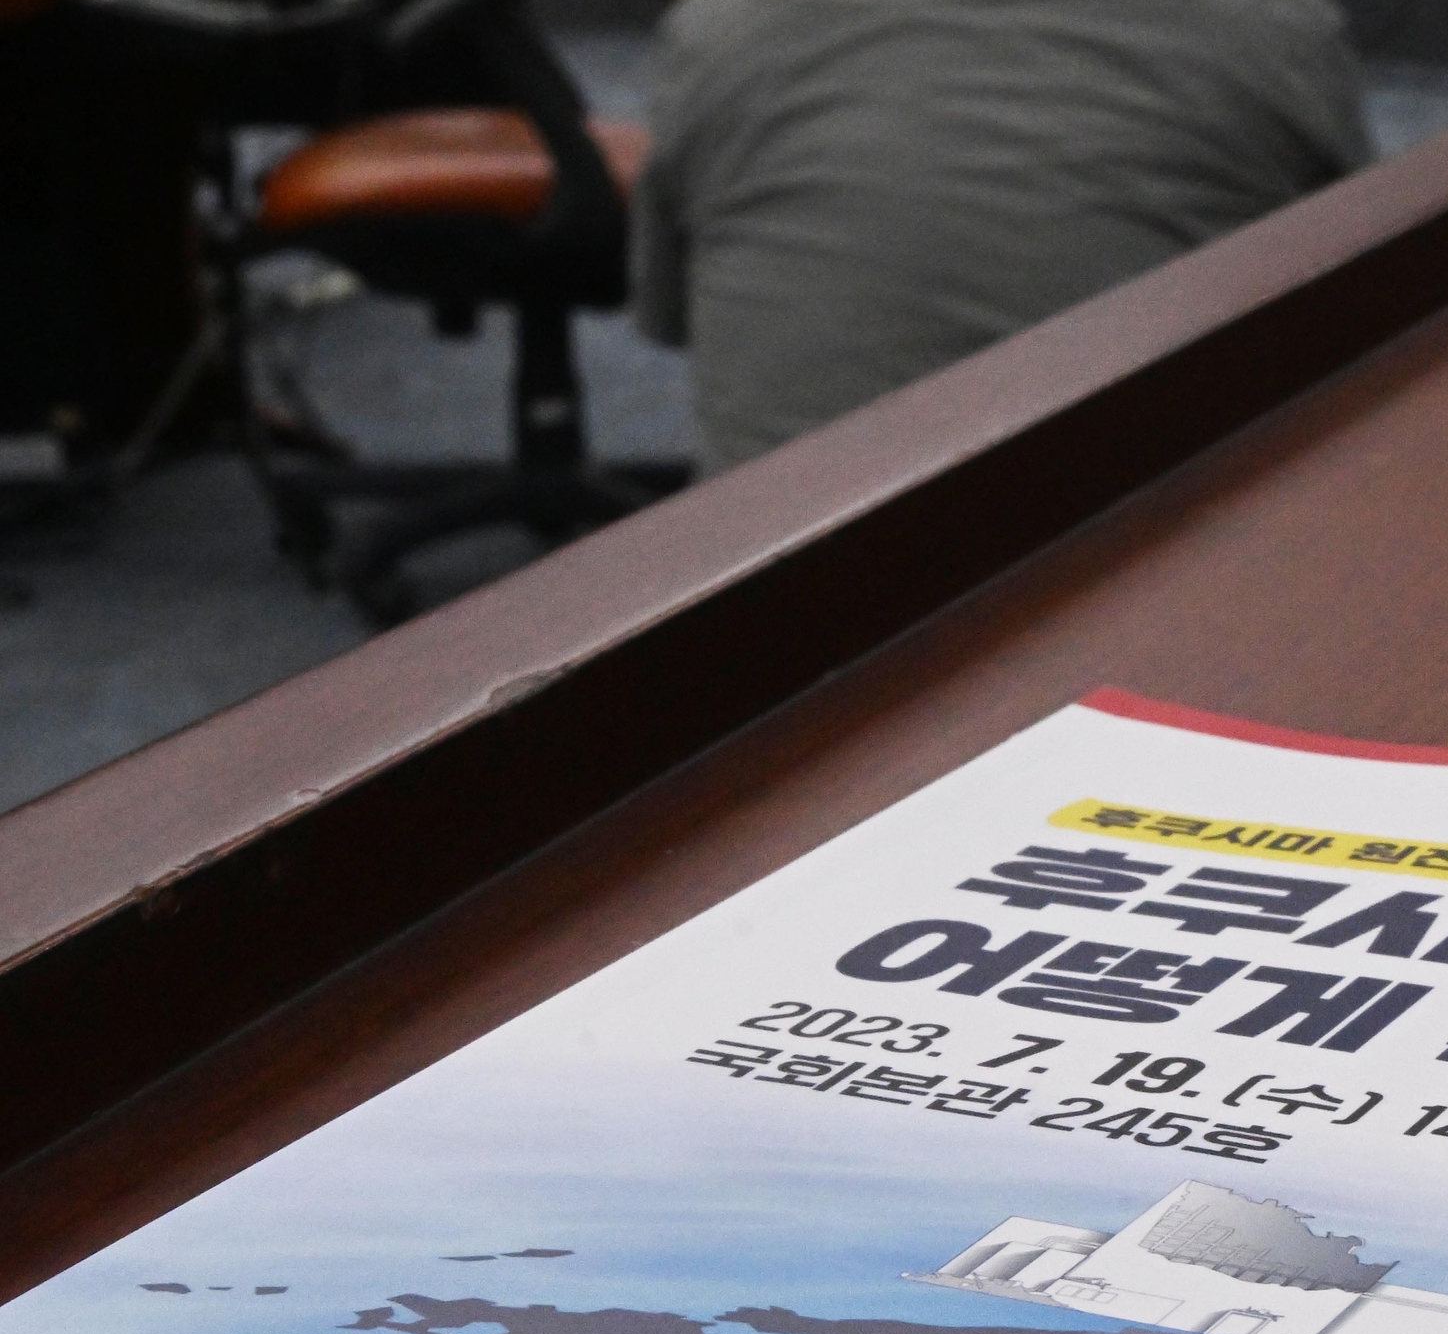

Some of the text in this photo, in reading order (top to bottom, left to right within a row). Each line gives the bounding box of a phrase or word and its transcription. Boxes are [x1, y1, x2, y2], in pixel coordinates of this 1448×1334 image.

[1081, 805, 1336, 856] 후쿠시마
[835, 918, 1435, 1054] 어떻게
[739, 1000, 950, 1059] 2023.
[978, 1034, 1046, 1075] 7.
[686, 1041, 1294, 1165] 국회본관 245호
